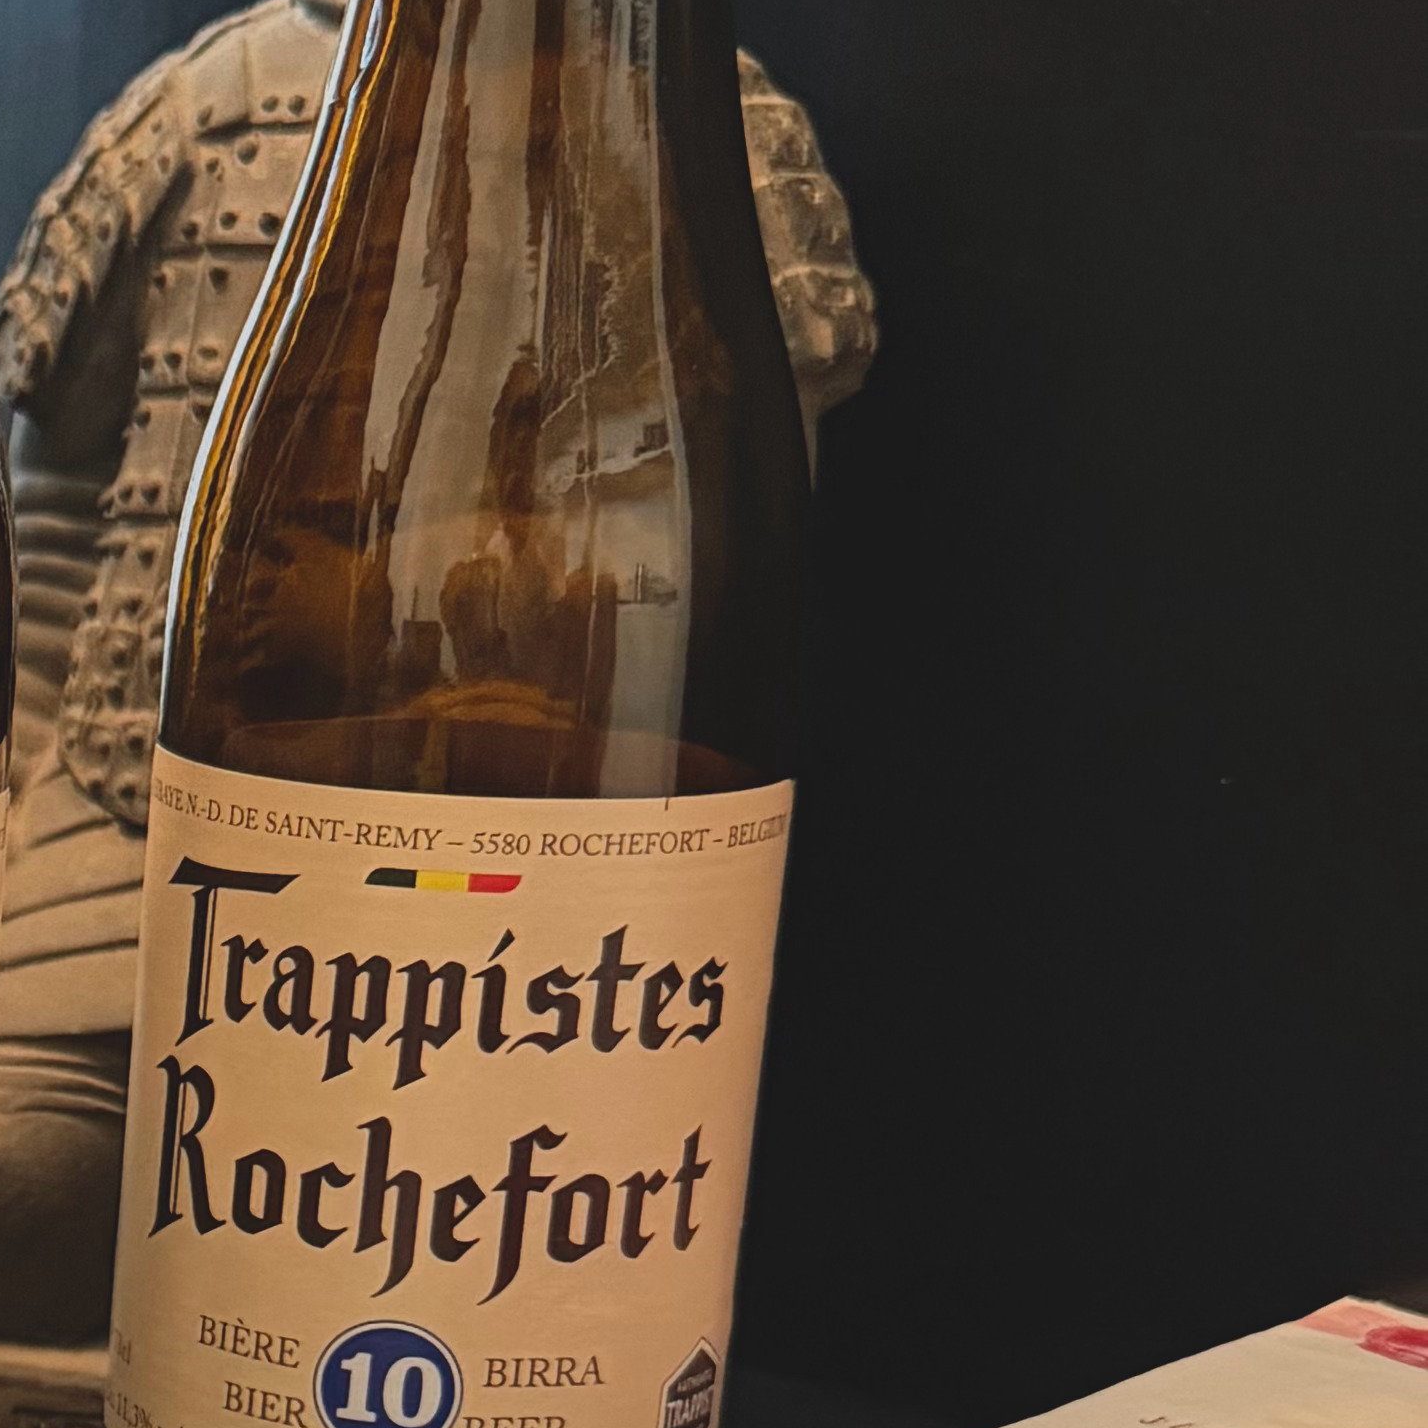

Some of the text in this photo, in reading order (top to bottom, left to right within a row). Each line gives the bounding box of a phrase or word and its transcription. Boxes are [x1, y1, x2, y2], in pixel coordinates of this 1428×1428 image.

[228, 804, 259, 831] DE
[265, 811, 443, 853] SAINT-REMY
[472, 831, 532, 857] 5580
[538, 828, 711, 857] ROCHEFORT
[169, 856, 729, 1090] Trappistes
[148, 1053, 713, 1306] Rochefort
[198, 1314, 301, 1369] BIÈRE
[483, 1356, 605, 1390] BIRRA
